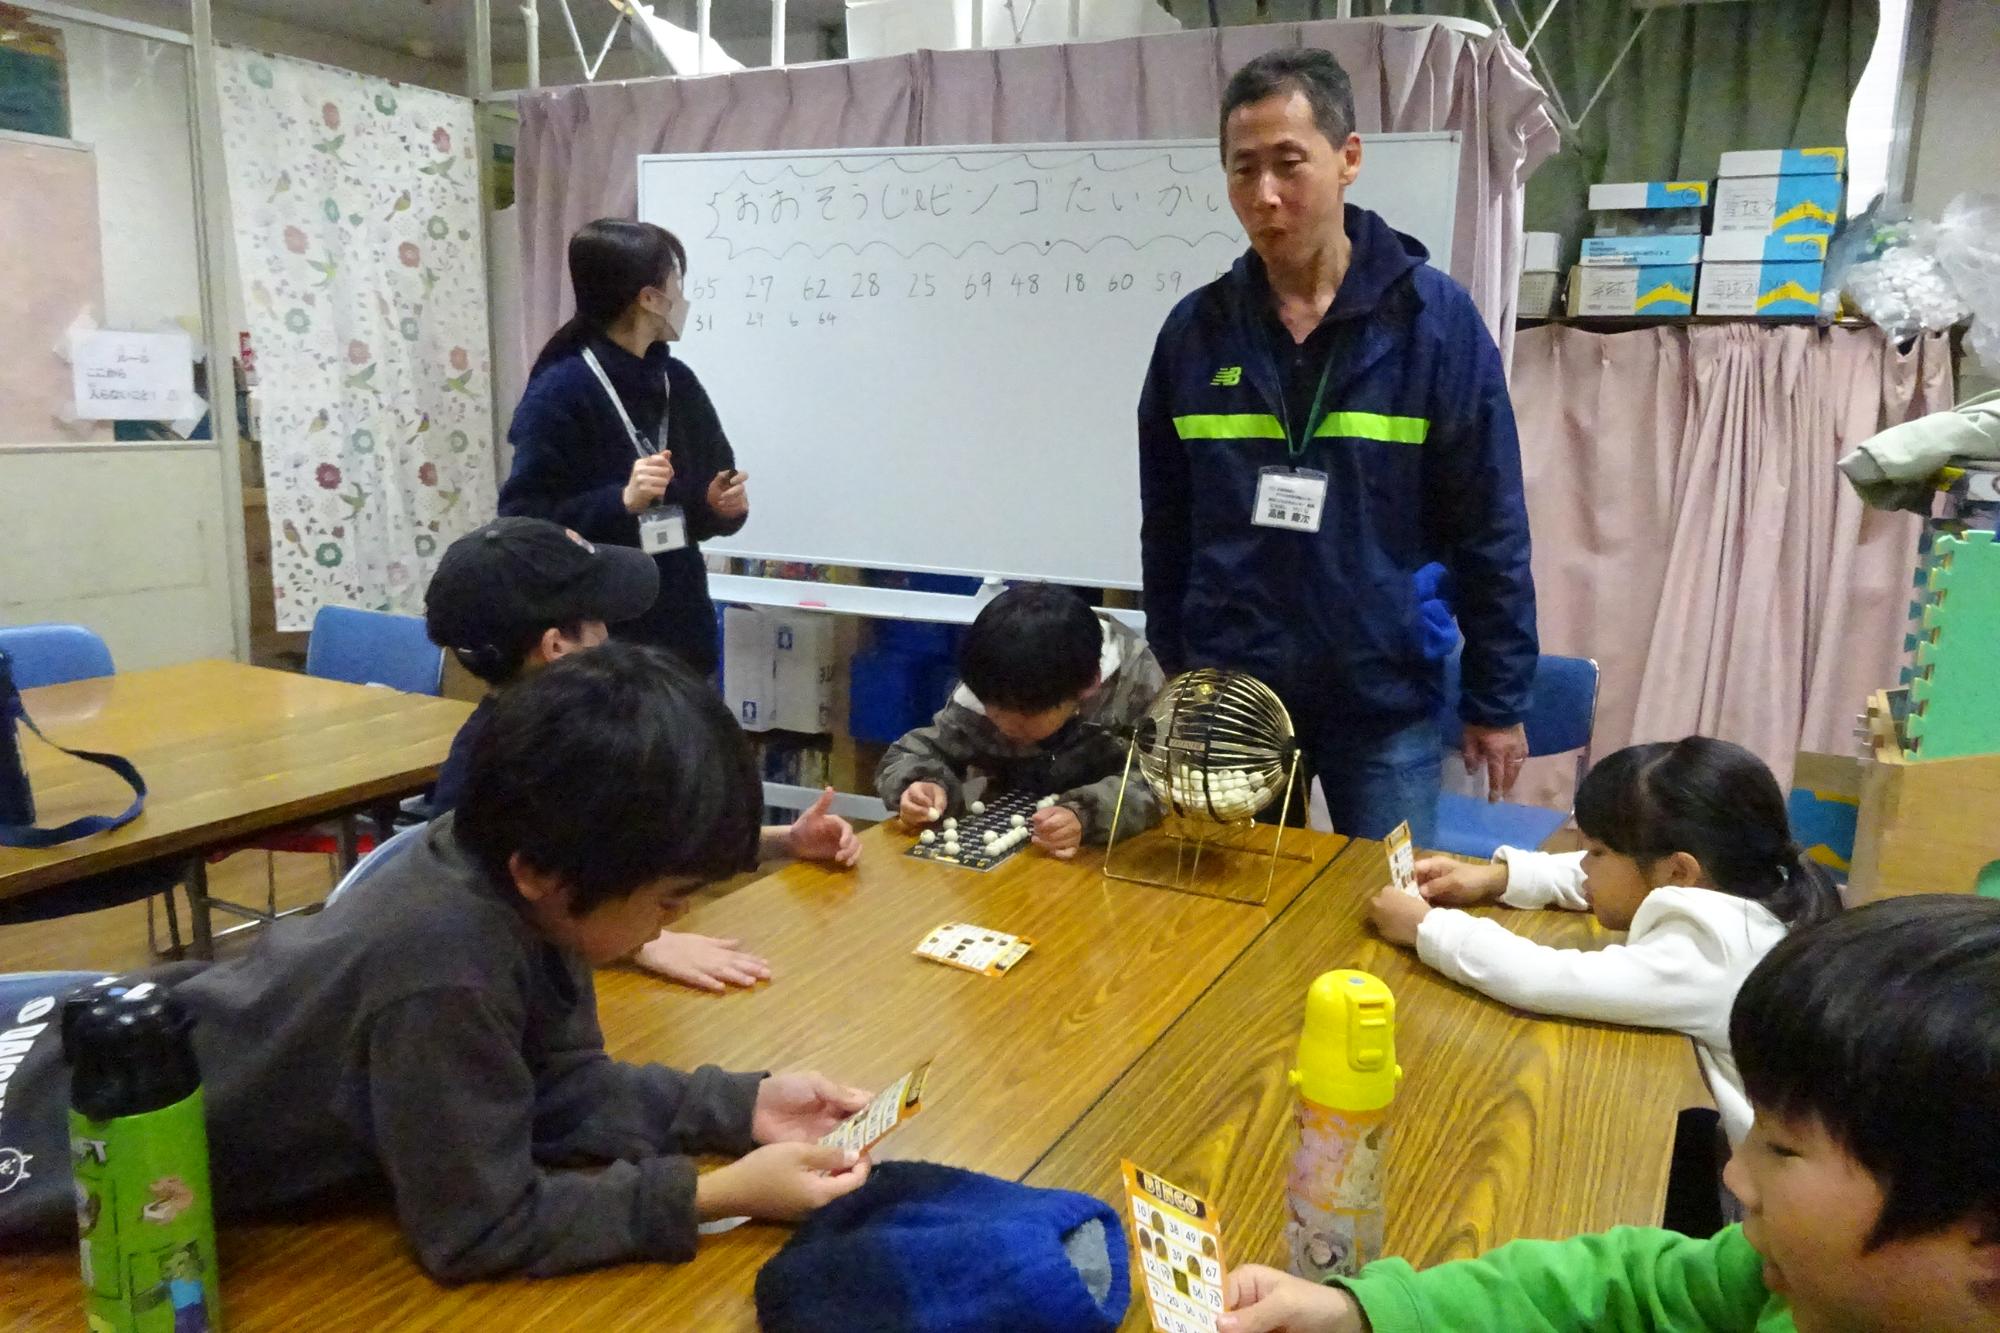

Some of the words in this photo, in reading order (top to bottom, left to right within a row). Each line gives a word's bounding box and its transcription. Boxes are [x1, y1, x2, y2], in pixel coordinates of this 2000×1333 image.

[693, 276, 719, 299] 65
[745, 275, 773, 302] 27
[803, 275, 830, 300] 62
[851, 273, 880, 298] 28
[907, 274, 936, 298] 25
[964, 272, 992, 300] 69
[1010, 273, 1039, 296] 48
[1065, 273, 1086, 293] 18
[1108, 273, 1133, 291] 60
[1155, 271, 1182, 294] 59
[696, 313, 713, 331] 31
[818, 312, 837, 327] 64
[1143, 1174, 1198, 1216] BINGO
[1185, 1231, 1197, 1244] 49
[1205, 1265, 1217, 1279] 67
